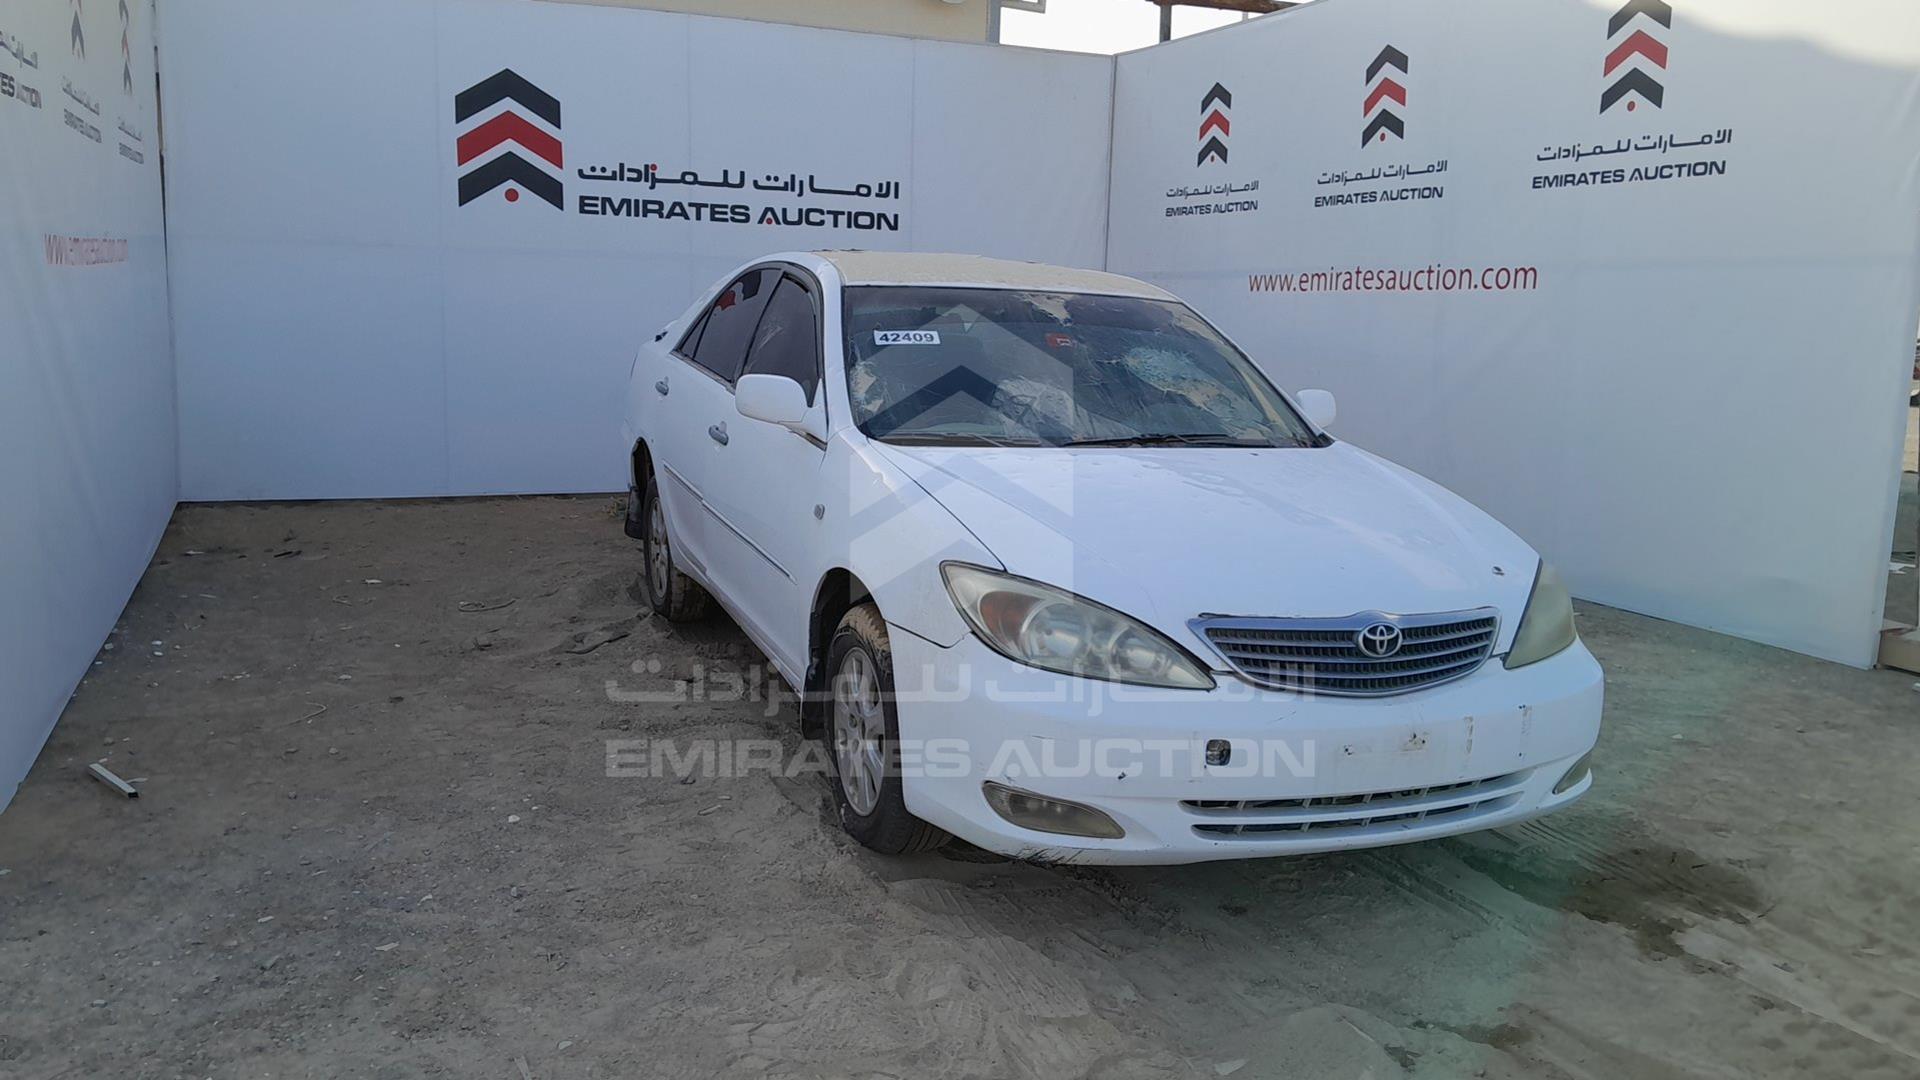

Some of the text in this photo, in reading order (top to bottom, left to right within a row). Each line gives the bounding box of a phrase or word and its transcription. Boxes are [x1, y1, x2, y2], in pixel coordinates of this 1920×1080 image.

[1532, 160, 1727, 189] EMIRATES AUCTION
[1165, 200, 1258, 217] EMIRATES AUCTION
[1314, 186, 1444, 207] EMIRATES AUCTION
[578, 195, 899, 231] EMIRATES AUCTION
[1249, 264, 1538, 292] www.emiratesauction.com
[880, 332, 934, 342] 42409
